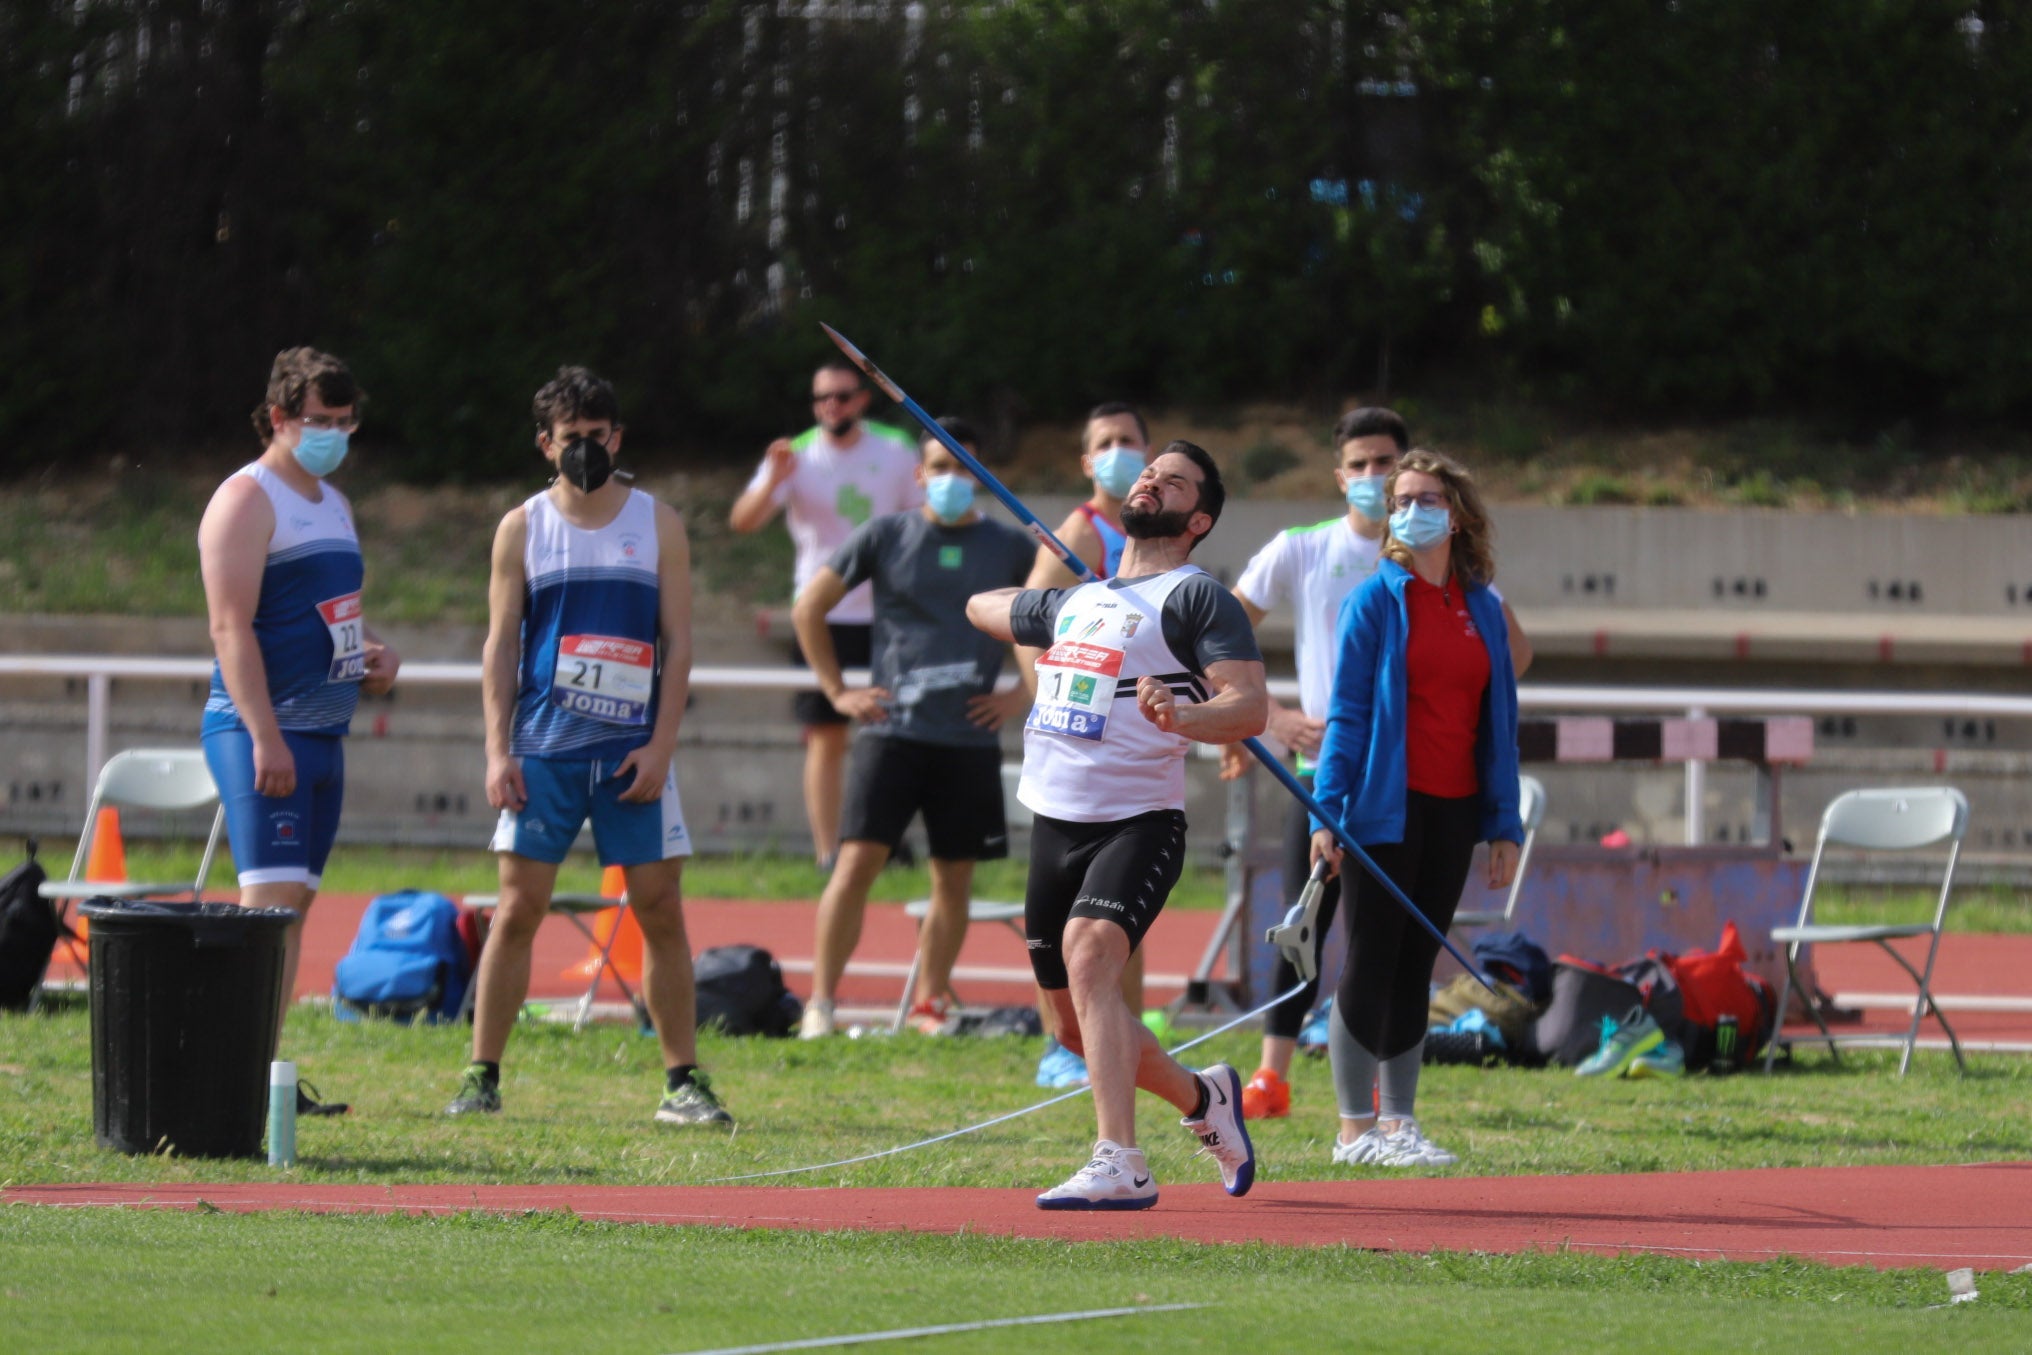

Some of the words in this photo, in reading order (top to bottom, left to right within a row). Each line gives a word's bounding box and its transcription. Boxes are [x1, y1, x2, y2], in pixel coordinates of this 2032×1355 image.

[340, 624, 358, 653] 22
[571, 660, 602, 690] 21
[1050, 672, 1063, 701] 1
[561, 691, 632, 720] Joma
[1033, 706, 1089, 733] Joma
[1199, 1131, 1220, 1147] IKE
